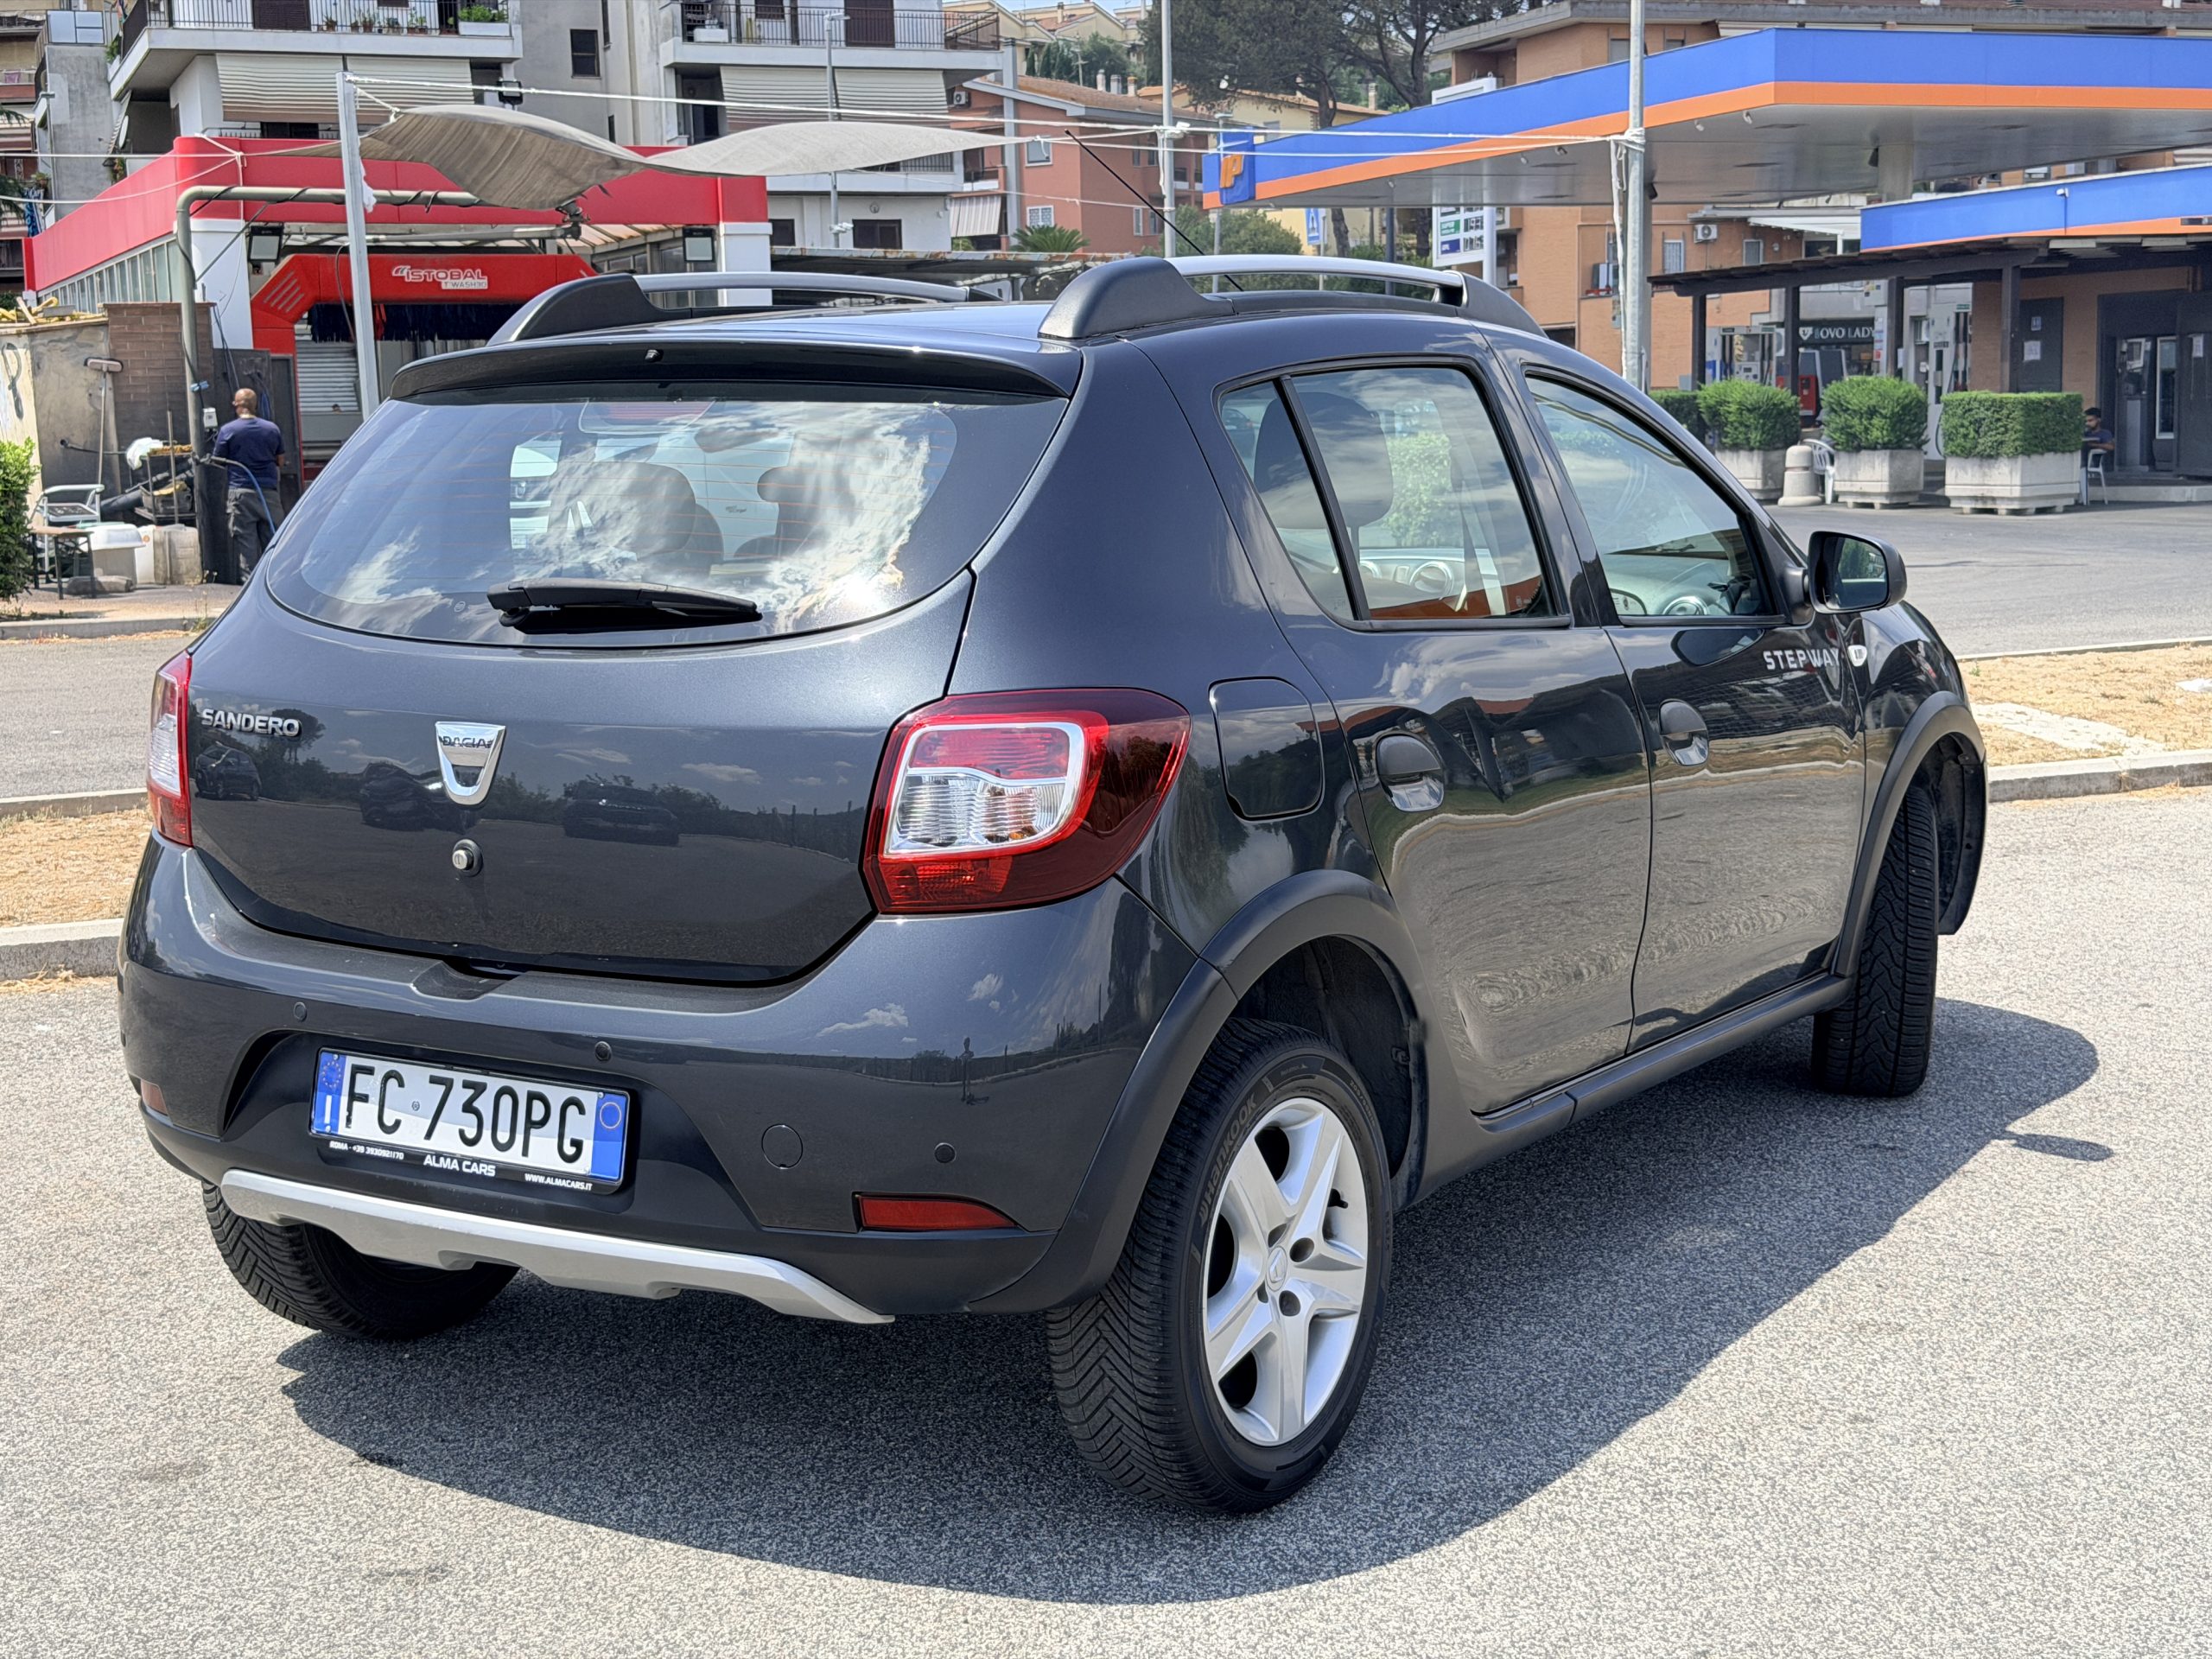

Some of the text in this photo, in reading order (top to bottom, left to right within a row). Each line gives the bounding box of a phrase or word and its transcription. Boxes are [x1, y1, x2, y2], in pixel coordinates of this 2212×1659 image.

[404, 268, 487, 282] ISTOBAL
[1763, 648, 1840, 670] STEPWAY
[200, 709, 301, 737] SANDERO
[442, 735, 488, 749] DACIA
[346, 1064, 586, 1164] FC 730PG
[329, 1141, 348, 1151] ROMA
[423, 1154, 496, 1178] ALMA CARS
[524, 1173, 593, 1192] WWW.ALMACARS.IT
